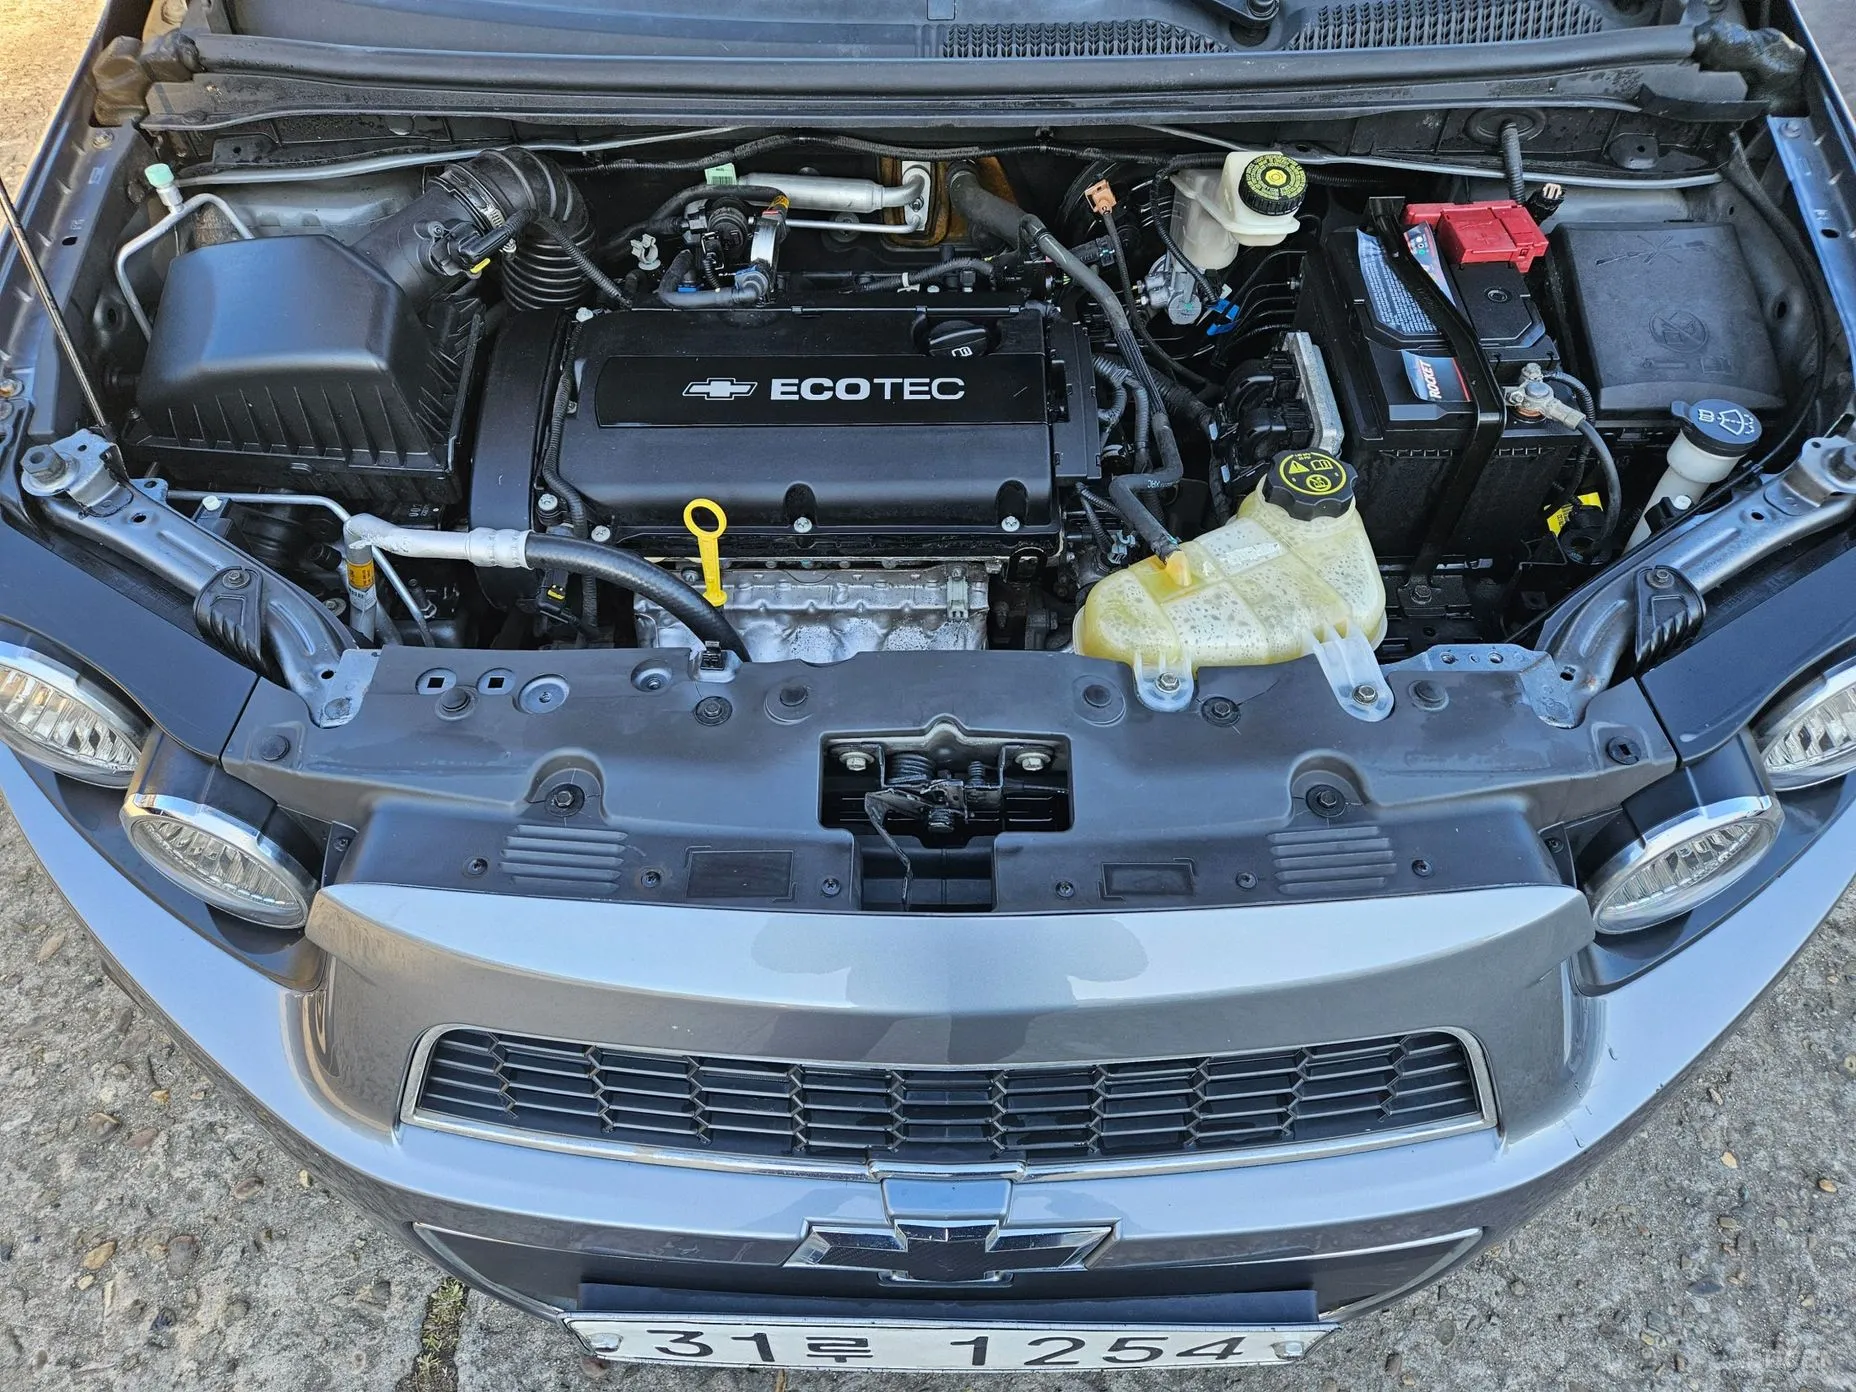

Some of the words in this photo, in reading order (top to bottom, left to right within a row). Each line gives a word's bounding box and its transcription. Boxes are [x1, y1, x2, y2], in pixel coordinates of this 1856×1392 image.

[770, 377, 965, 401] ECOTEC
[1420, 360, 1442, 399] ROCKET
[646, 1329, 874, 1364] 31루
[950, 1336, 1247, 1366] 1254
